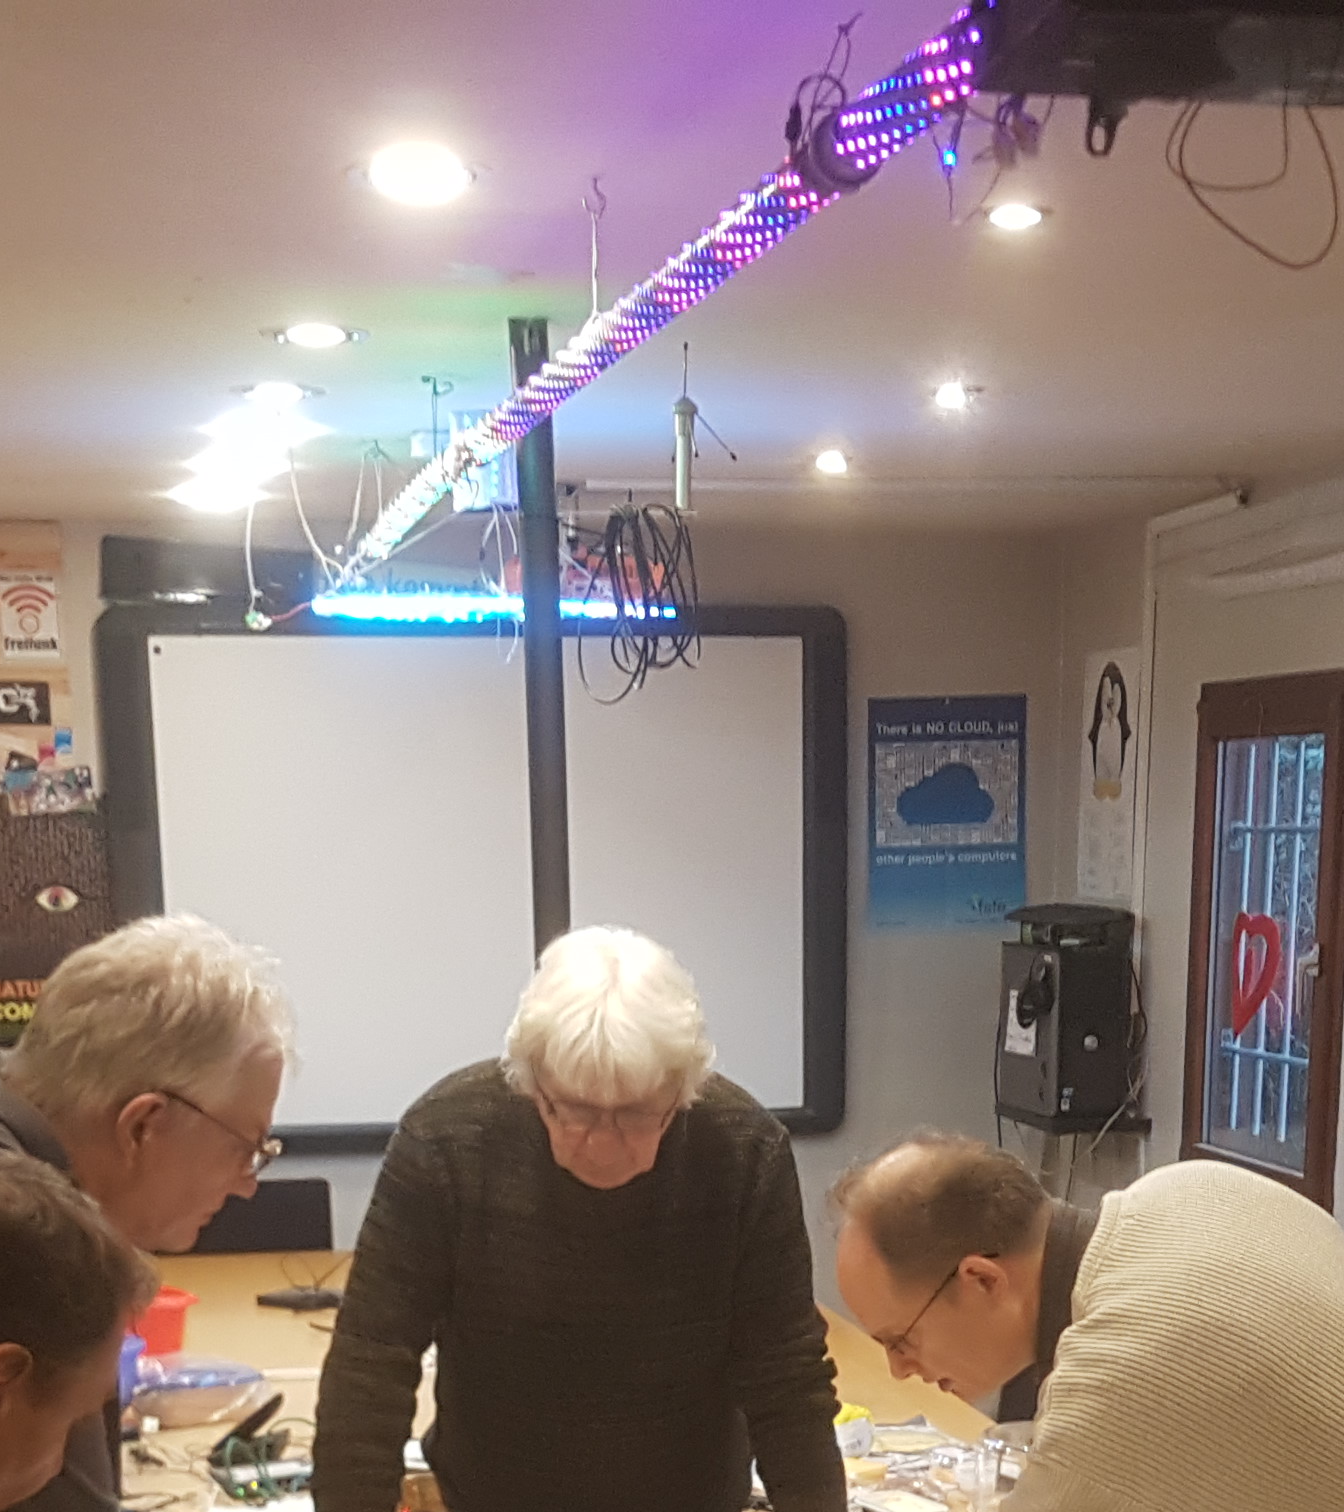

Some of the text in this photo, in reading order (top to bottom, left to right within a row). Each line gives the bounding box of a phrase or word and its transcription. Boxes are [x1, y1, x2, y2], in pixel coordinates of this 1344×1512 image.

[876, 722, 907, 735] There
[912, 723, 922, 734] is
[926, 721, 945, 734] NO
[875, 850, 1018, 867] other people's computers
